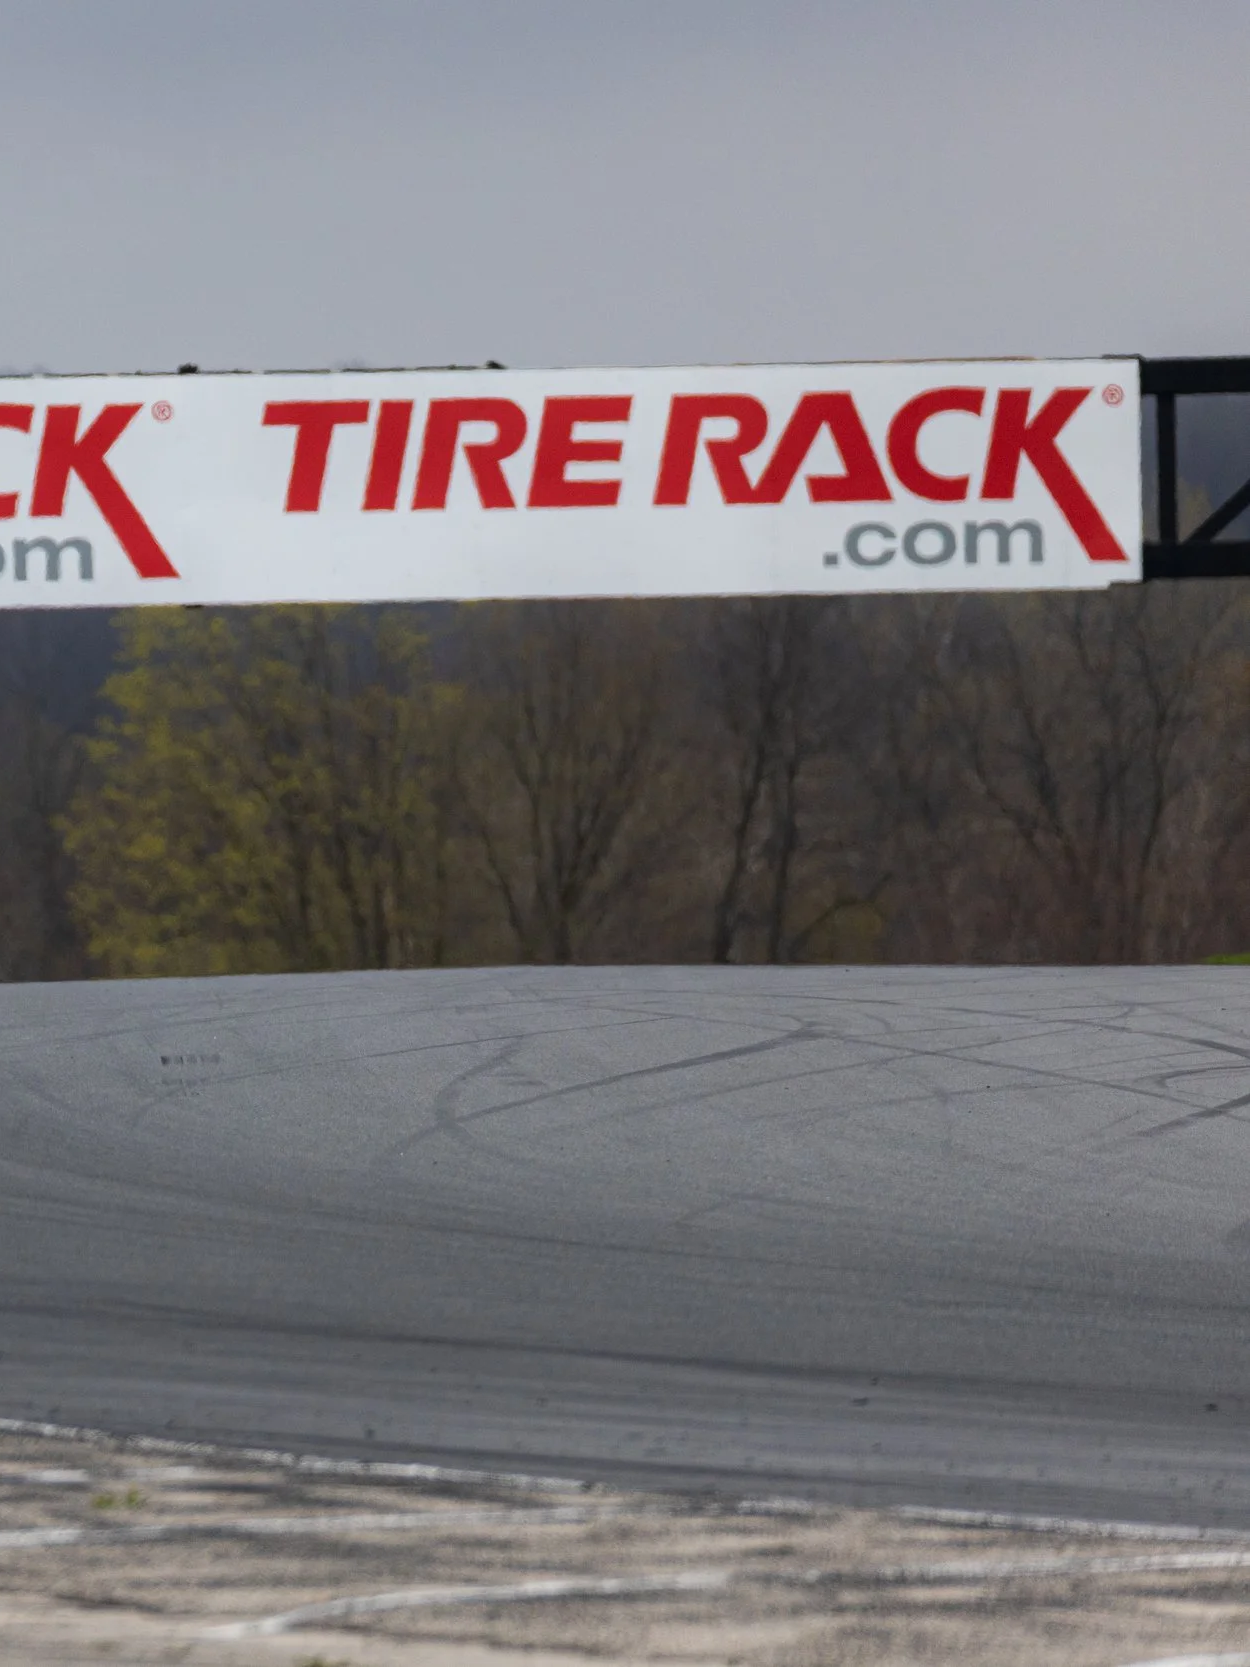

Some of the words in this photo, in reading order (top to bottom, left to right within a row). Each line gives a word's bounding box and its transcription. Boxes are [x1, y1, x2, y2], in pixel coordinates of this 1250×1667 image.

[262, 395, 633, 512] TIRE
[654, 387, 1127, 561] RACK
[824, 520, 1044, 568] .com
